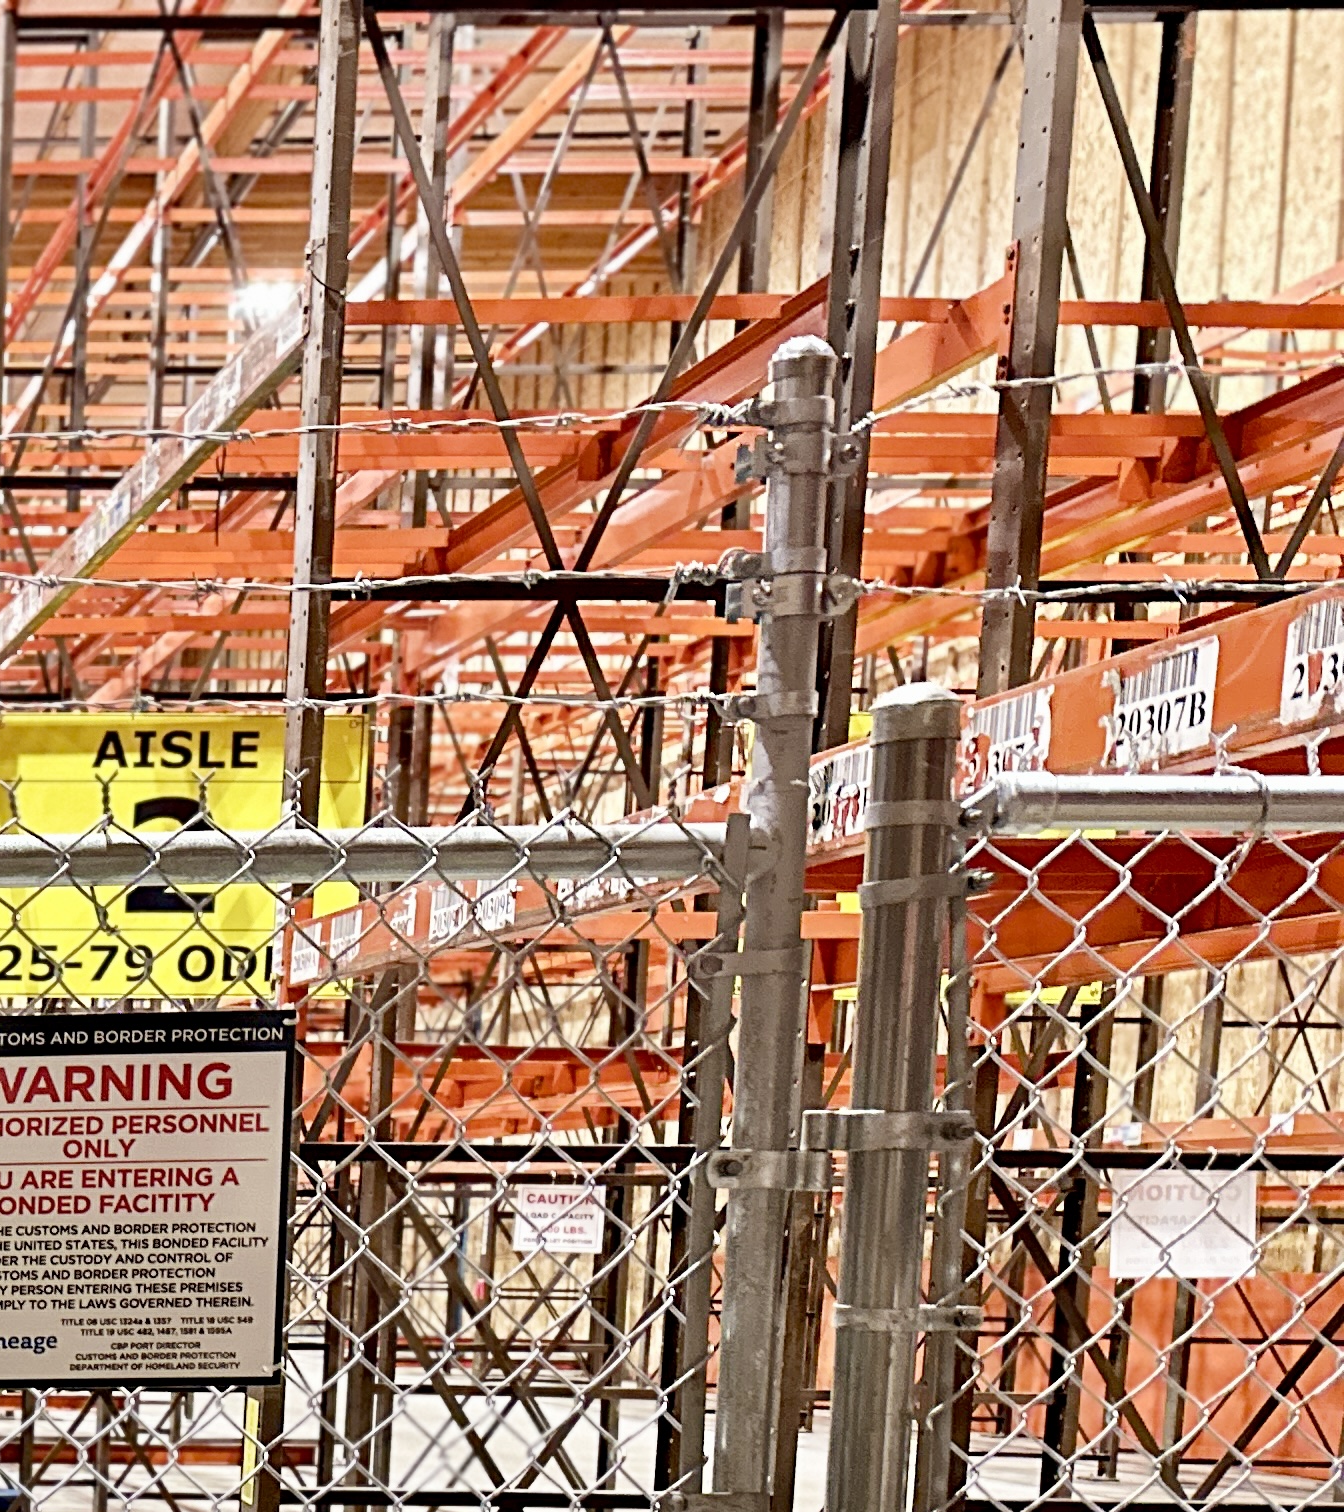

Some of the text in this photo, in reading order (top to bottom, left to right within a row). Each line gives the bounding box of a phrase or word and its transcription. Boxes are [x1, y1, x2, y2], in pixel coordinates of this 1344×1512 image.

[1115, 691, 1207, 747] 20307B
[92, 730, 261, 769] AISLE
[177, 944, 273, 982] OD
[50, 1031, 89, 1045] AND
[93, 1029, 166, 1044] BORDER
[171, 1027, 283, 1042] PROTECTION
[112, 1113, 270, 1135] PERSONNEL
[62, 1138, 136, 1158] ONLY
[20, 1170, 74, 1189] ARE
[81, 1167, 213, 1188] ENTERING
[220, 1167, 240, 1186] A
[99, 1193, 215, 1213] FACITITY
[16, 1225, 78, 1236] CUSTOMS
[81, 1224, 110, 1235] AND
[114, 1223, 168, 1235] BORDER
[172, 1222, 256, 1234] PROTECTION
[14, 1240, 62, 1251] UNITED
[65, 1239, 117, 1251] STATES,
[120, 1238, 149, 1249] THIS
[153, 1238, 208, 1249] BONDED
[212, 1237, 269, 1248] FACILITY
[22, 1255, 47, 1265] THE
[50, 1254, 112, 1265] CUSTODY
[115, 1254, 144, 1264] AND
[147, 1253, 211, 1264] CONTROL
[214, 1252, 233, 1263] OF
[42, 1270, 70, 1280] AND
[73, 1269, 128, 1280] BORDER
[131, 1267, 216, 1279] PROTECTION
[11, 1284, 63, 1295] PERSON
[67, 1283, 132, 1294] ENTERING
[135, 1283, 177, 1293] THESE
[180, 1282, 243, 1293] PREMISES
[29, 1299, 47, 1310] TO
[50, 1299, 75, 1309] THE
[79, 1298, 116, 1309] LAWS
[119, 1297, 192, 1308] GOVERNED
[196, 1296, 254, 1308] THEREIN.
[61, 1318, 84, 1326] TITLE
[145, 1317, 151, 1325] &
[180, 1316, 204, 1324] TITLE
[217, 1316, 235, 1324] USC
[80, 1328, 104, 1336] TITLE
[117, 1328, 134, 1336] USC
[198, 1327, 205, 1335] &
[110, 1341, 201, 1350] CBP PORT DIRECTOR
[75, 1351, 236, 1361] CUSTOMS AND BORDER PROTECTION
[69, 1363, 128, 1371] DEPARTMENT
[145, 1362, 196, 1370] HOMELAND
[198, 1361, 241, 1370] SECURITY
